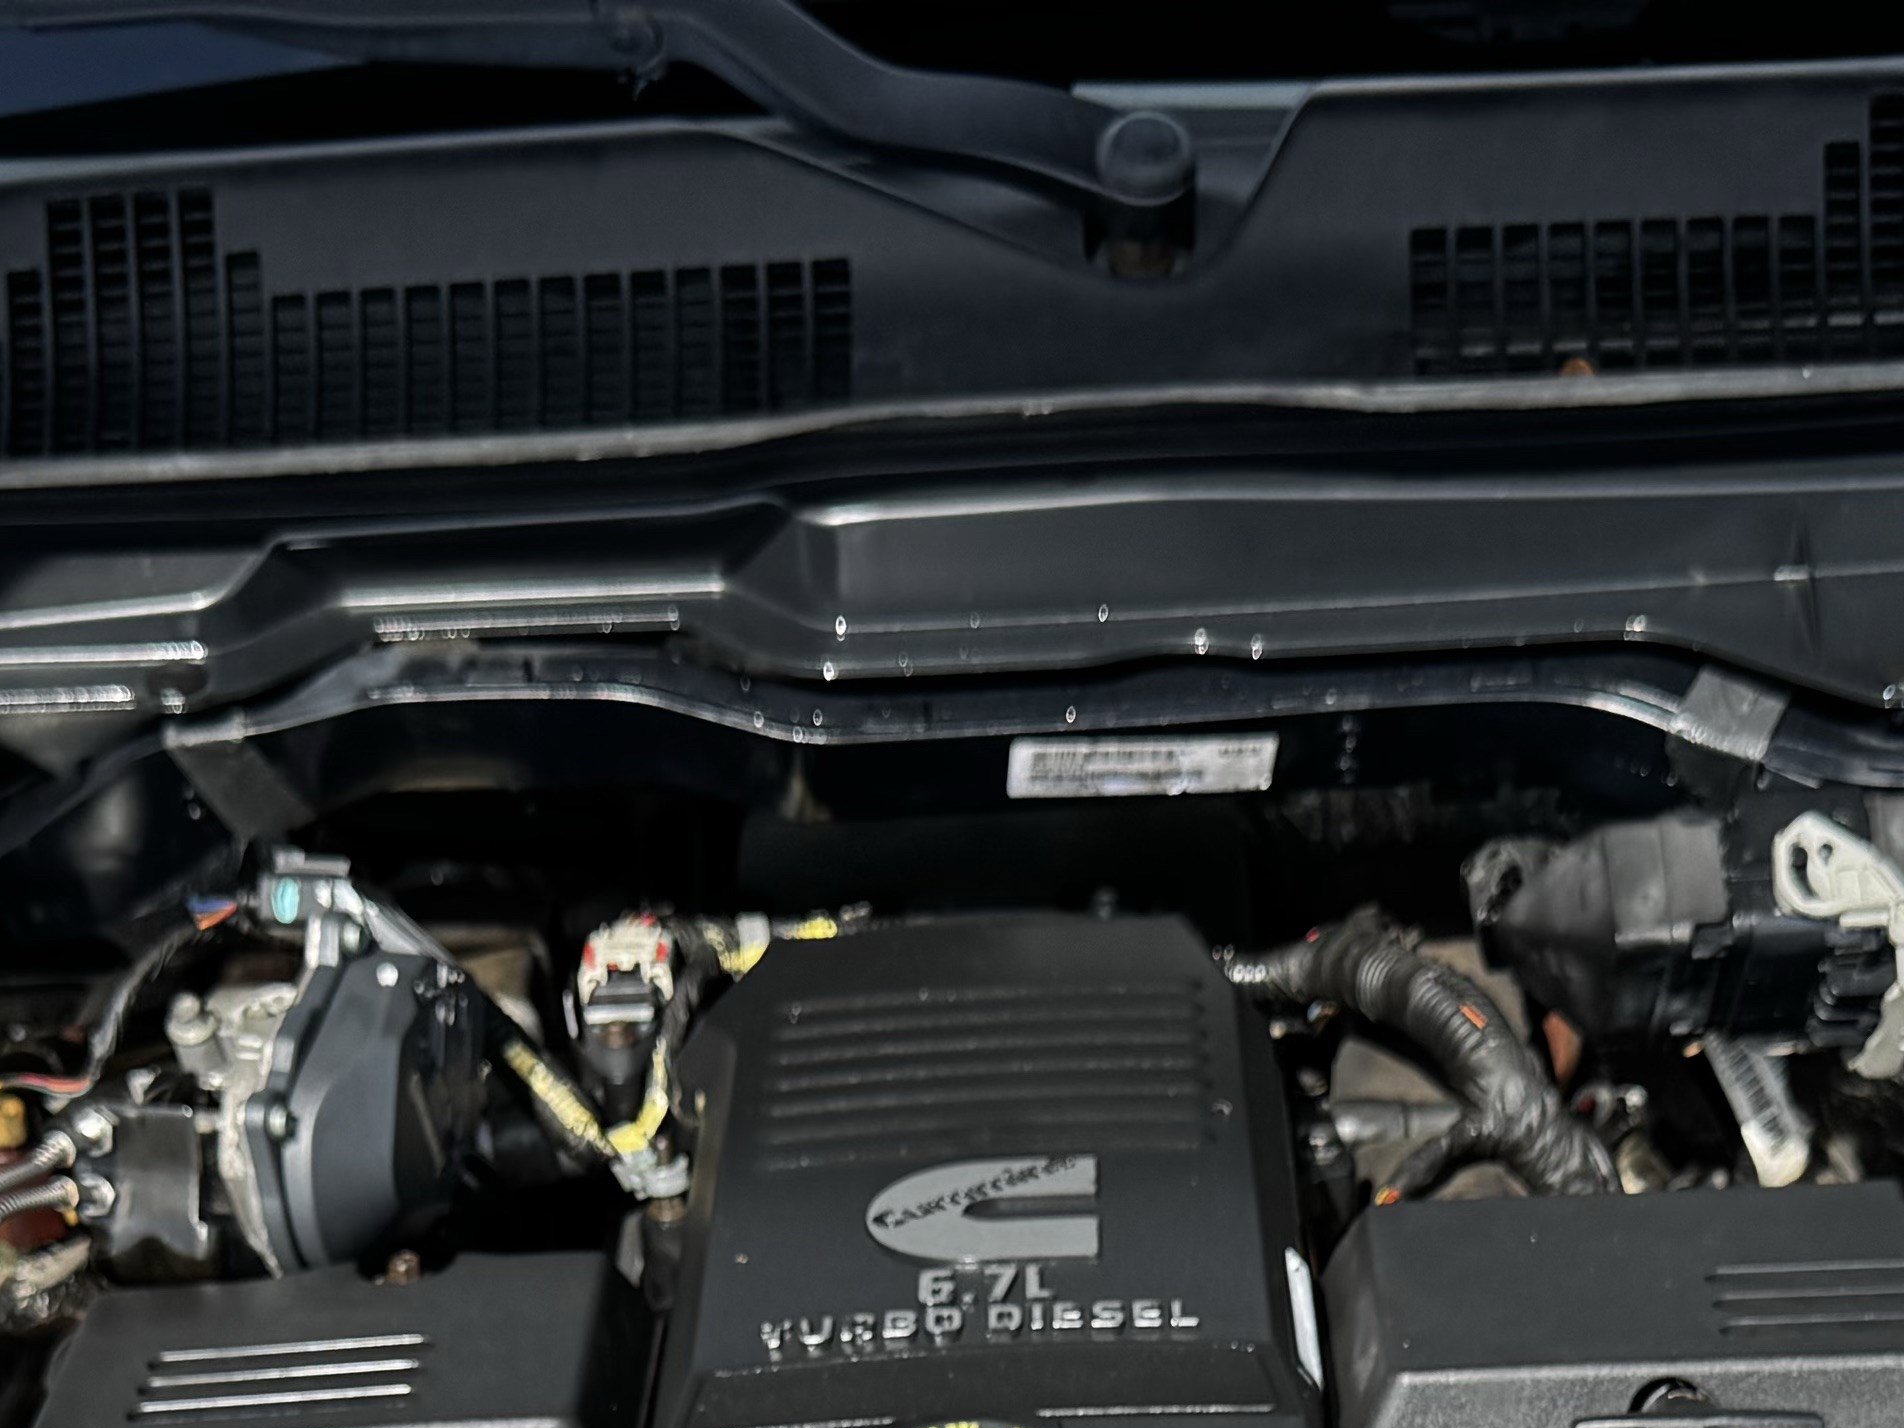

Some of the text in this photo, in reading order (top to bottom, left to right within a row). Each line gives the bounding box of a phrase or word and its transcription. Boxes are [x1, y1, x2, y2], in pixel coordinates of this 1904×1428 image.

[918, 1263, 1057, 1308] 6.7L
[759, 1298, 1200, 1351] TURBO DIESEL
